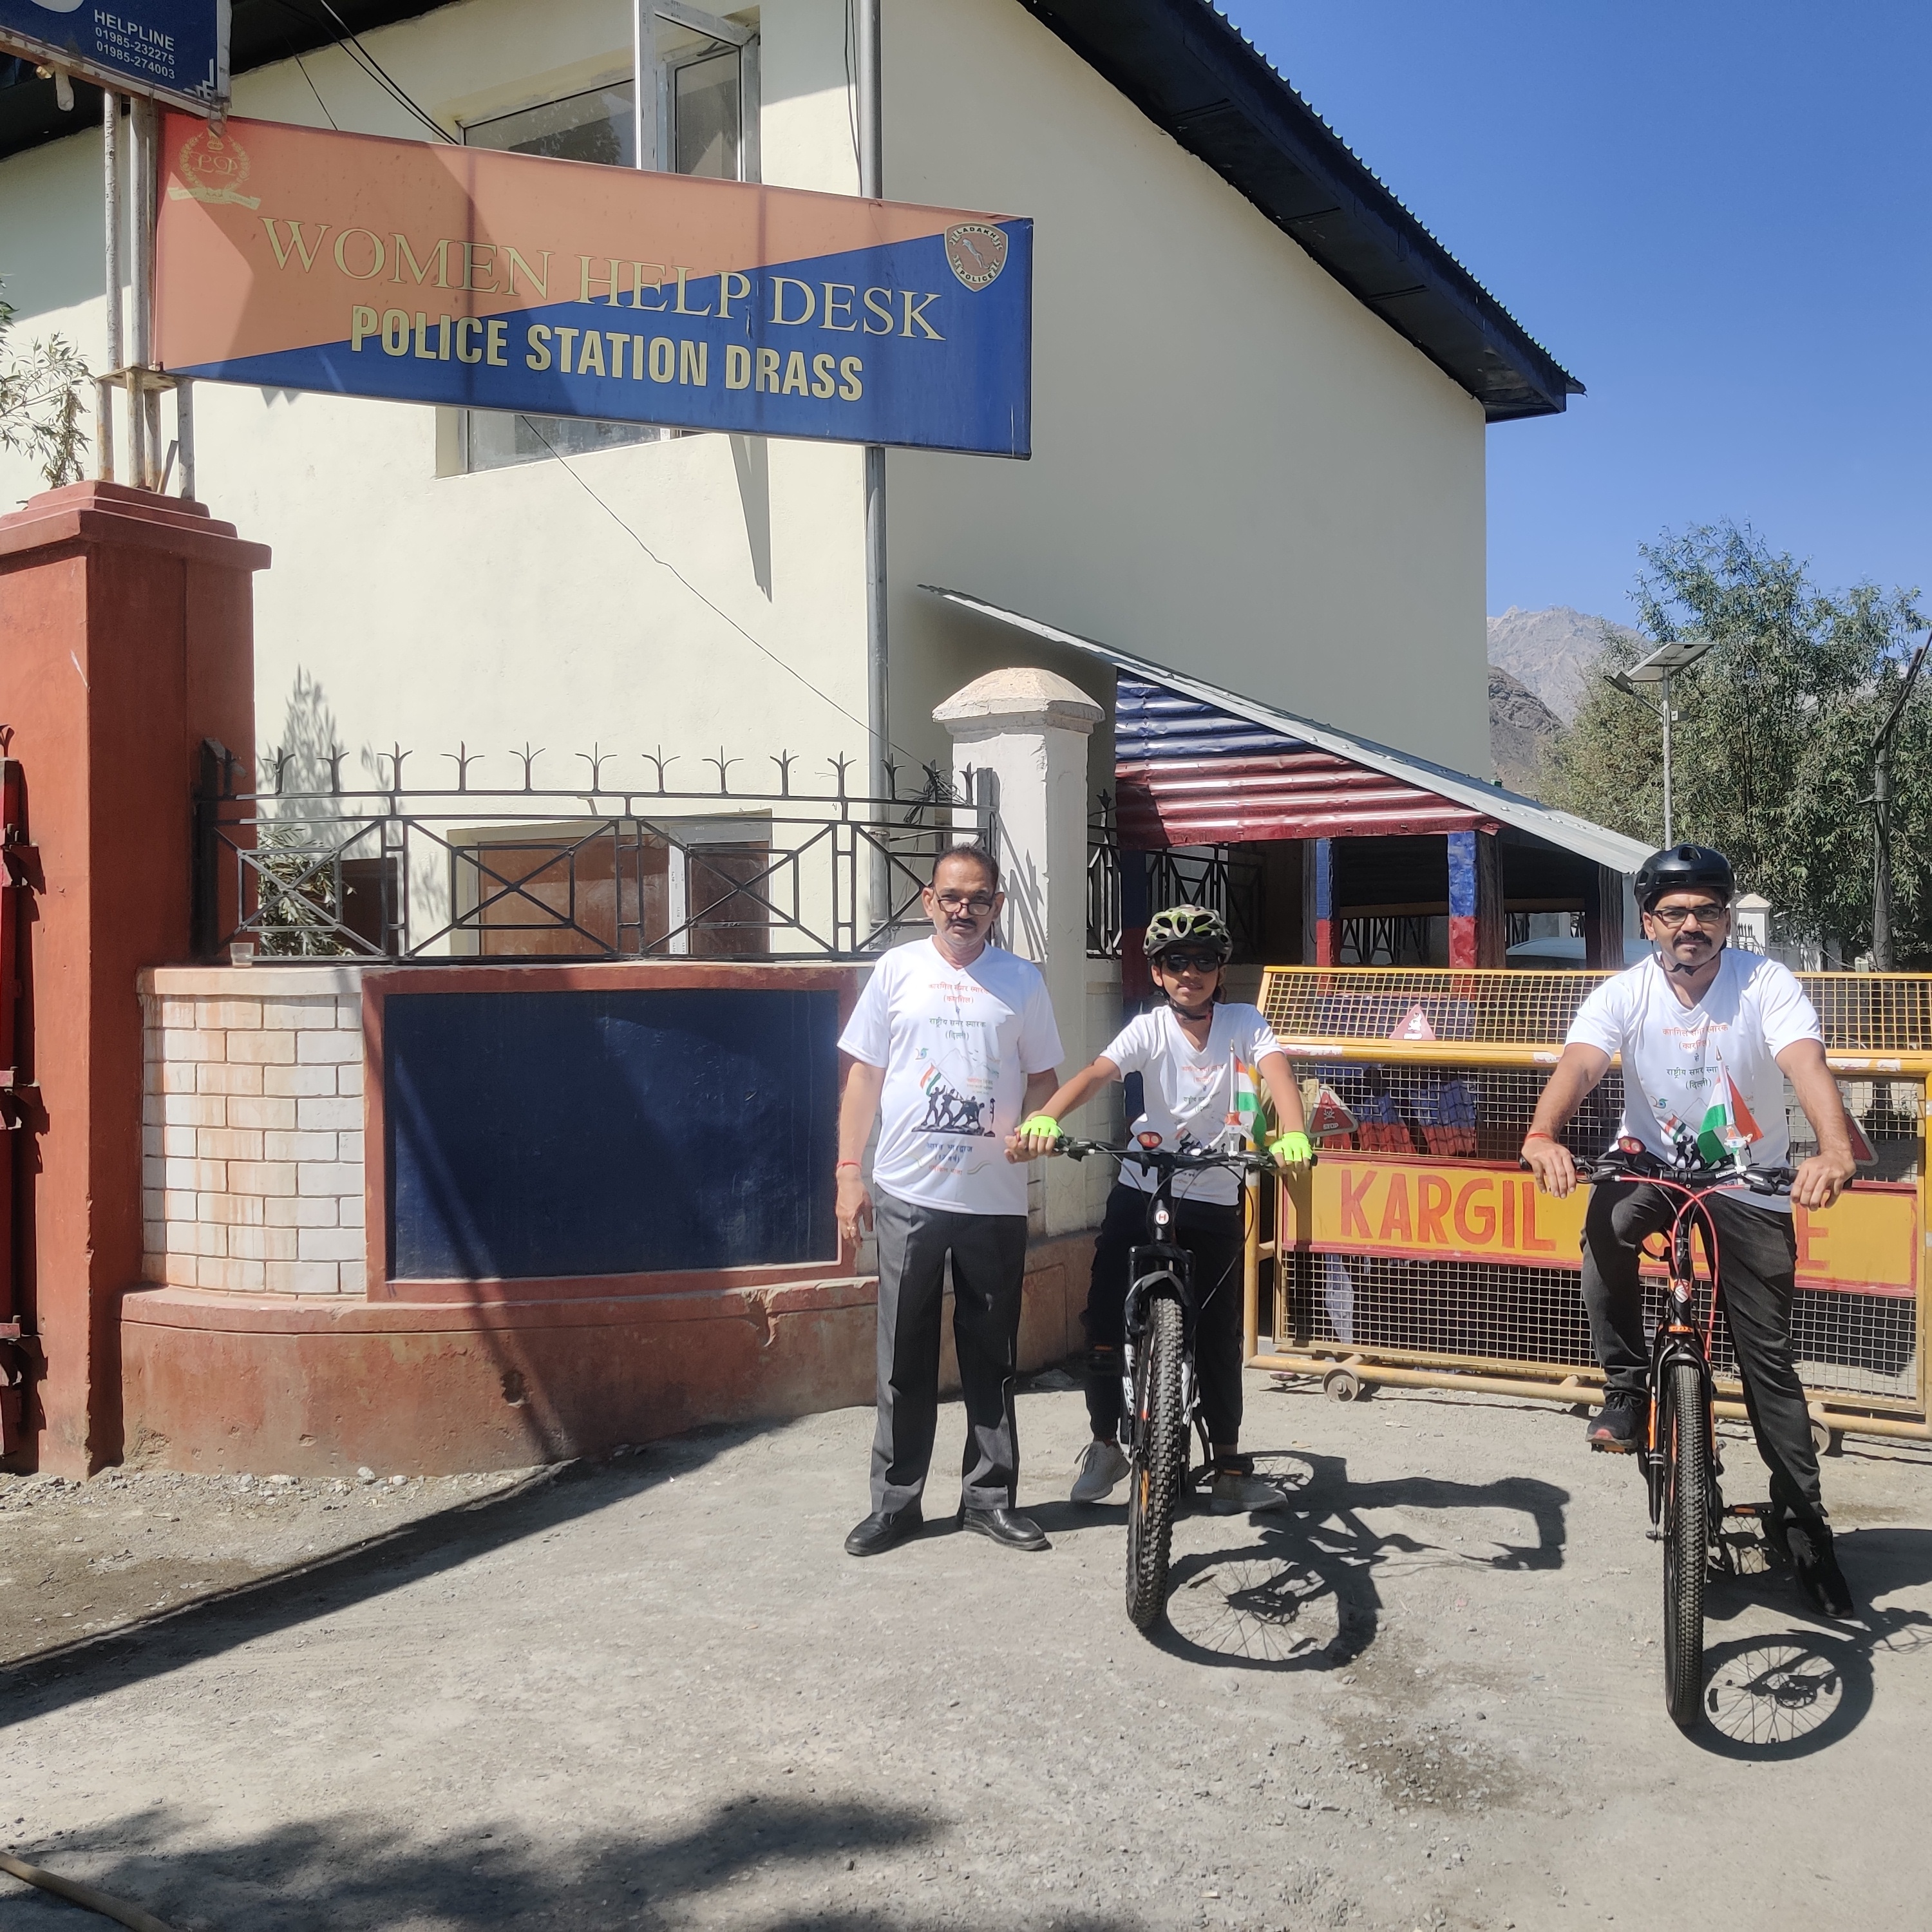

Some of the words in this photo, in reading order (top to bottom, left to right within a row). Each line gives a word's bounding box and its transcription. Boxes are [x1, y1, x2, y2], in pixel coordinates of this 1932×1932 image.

[94, 9, 175, 52] HELPLINE
[95, 27, 175, 65] 01985-232275
[97, 41, 175, 79] 01985-274003
[956, 227, 996, 238] LADAKH
[258, 216, 554, 300] WOMEN
[574, 254, 752, 319] HELP
[768, 276, 946, 341] DESK
[960, 270, 993, 282] POLICE
[351, 305, 509, 366] POLICE
[526, 323, 708, 387] STATION
[725, 344, 864, 402] DRASS
[1667, 1066, 1686, 1078] राष्ट्रीय
[1685, 1077, 1712, 1090] (दिल्ली)
[1341, 1169, 1557, 1251] KARGIL
